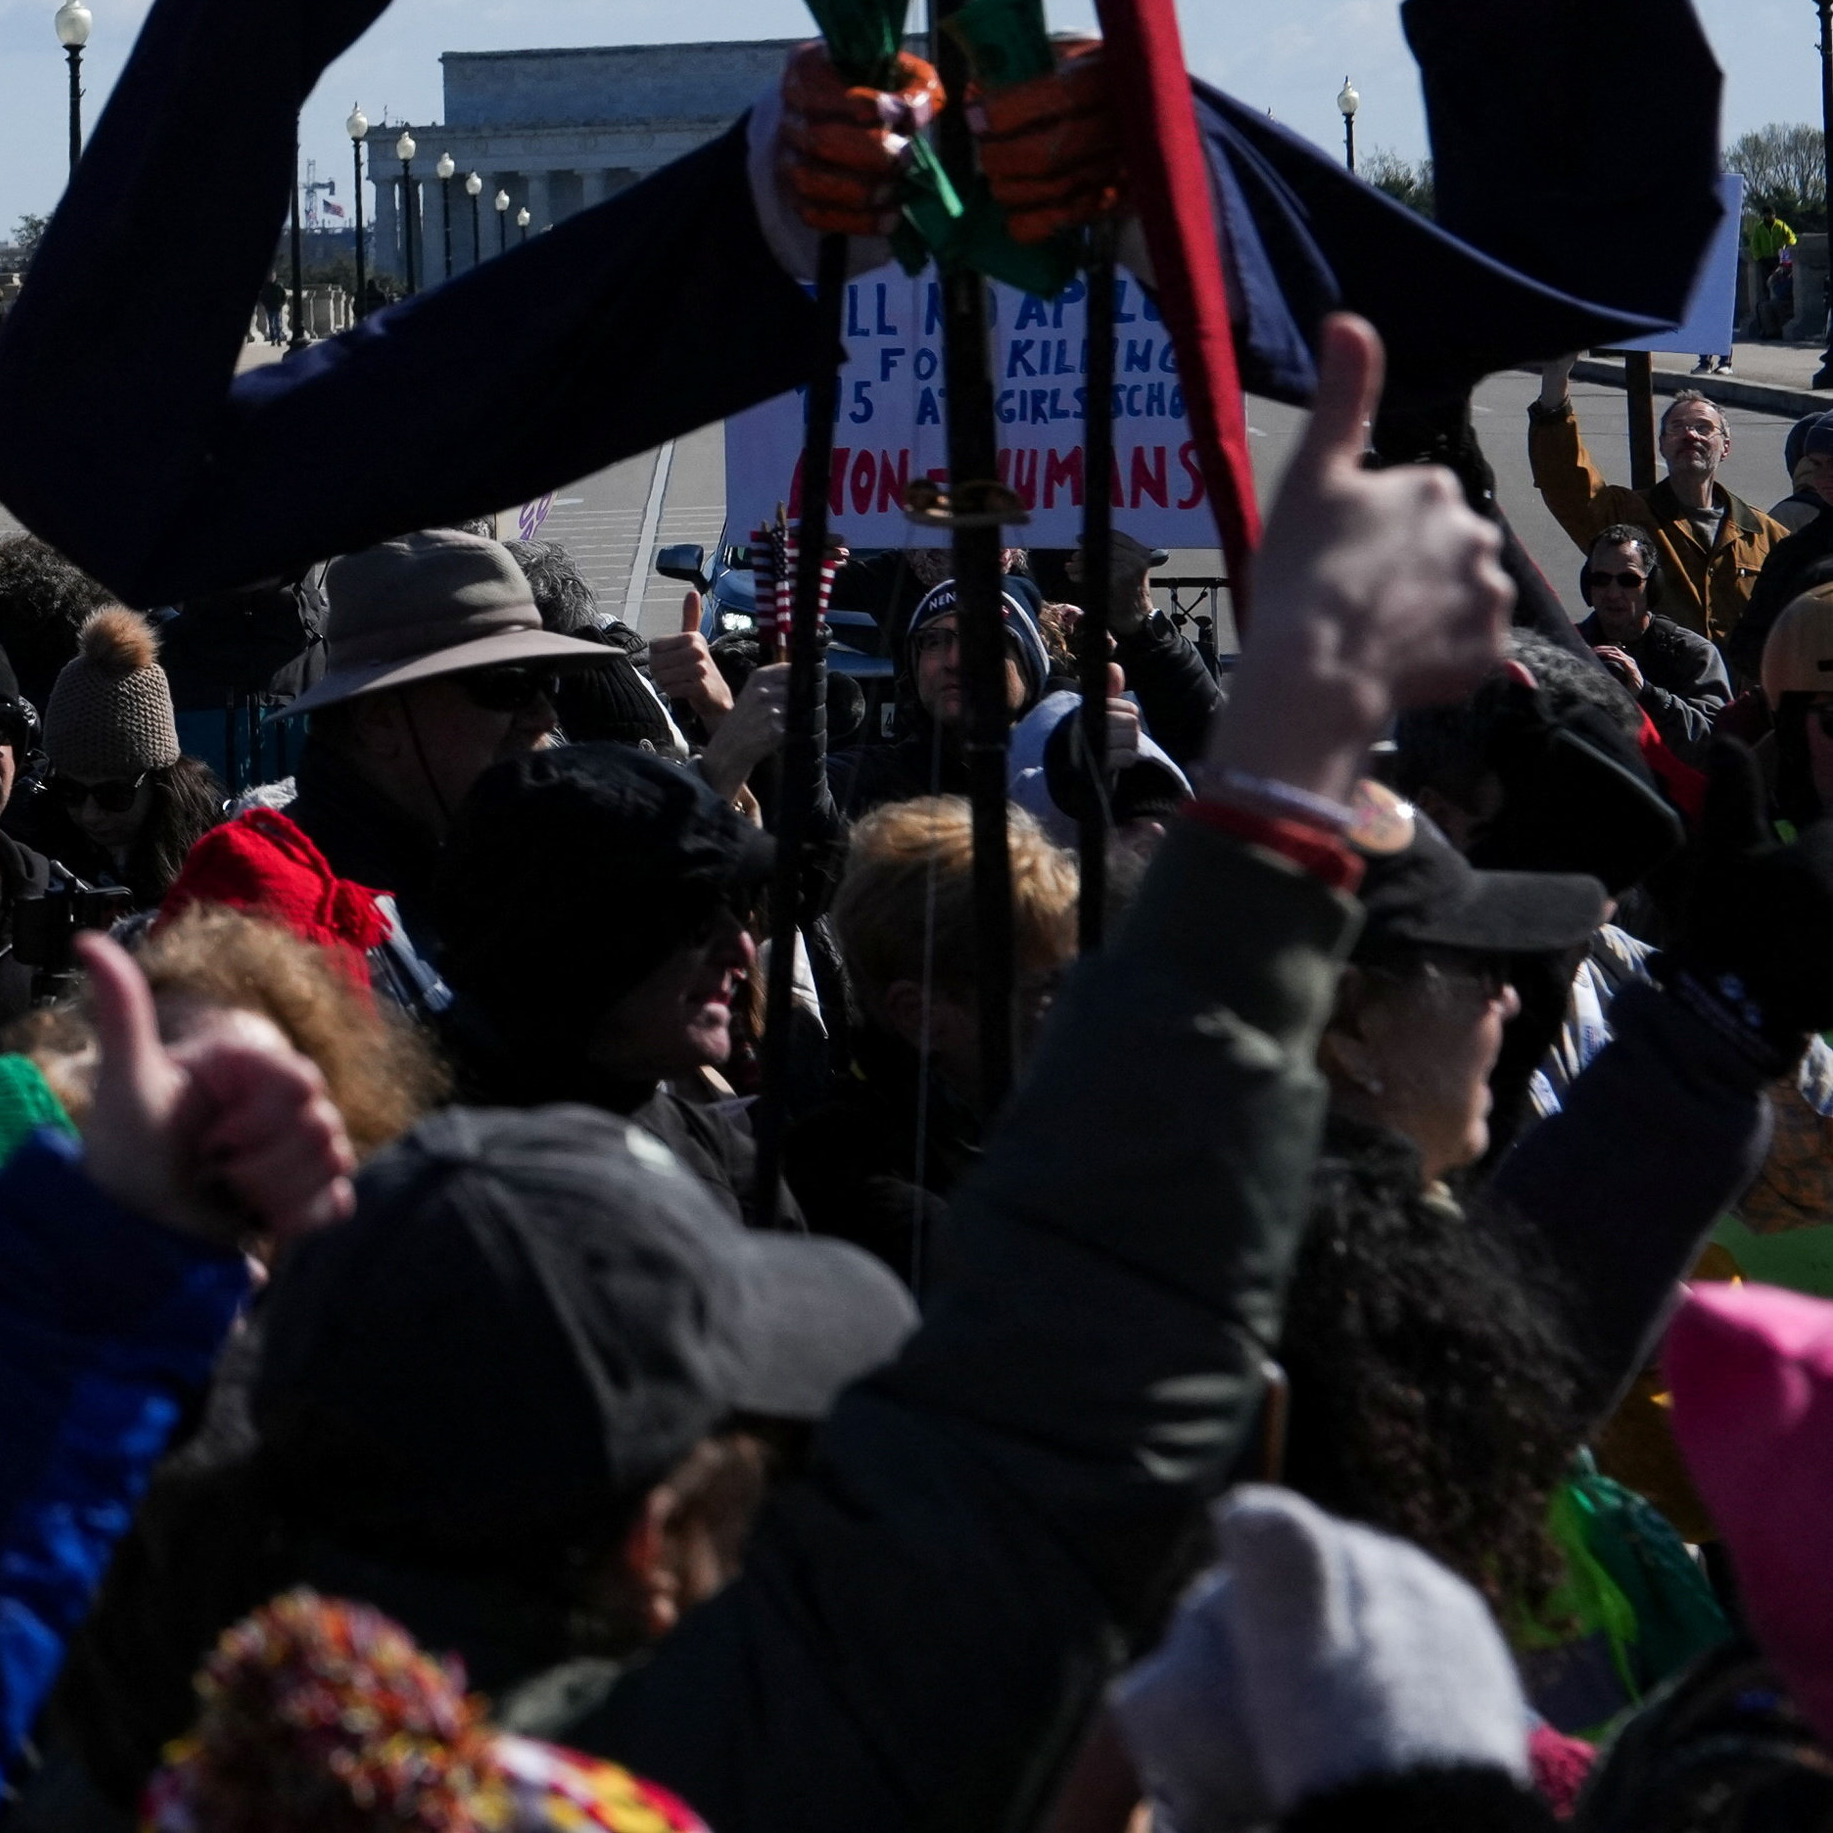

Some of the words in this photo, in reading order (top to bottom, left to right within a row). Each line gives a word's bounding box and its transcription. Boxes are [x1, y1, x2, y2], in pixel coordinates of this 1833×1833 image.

[880, 347, 946, 383] FO
[1109, 380, 1187, 420] SCHO
[929, 590, 957, 612] NEN
